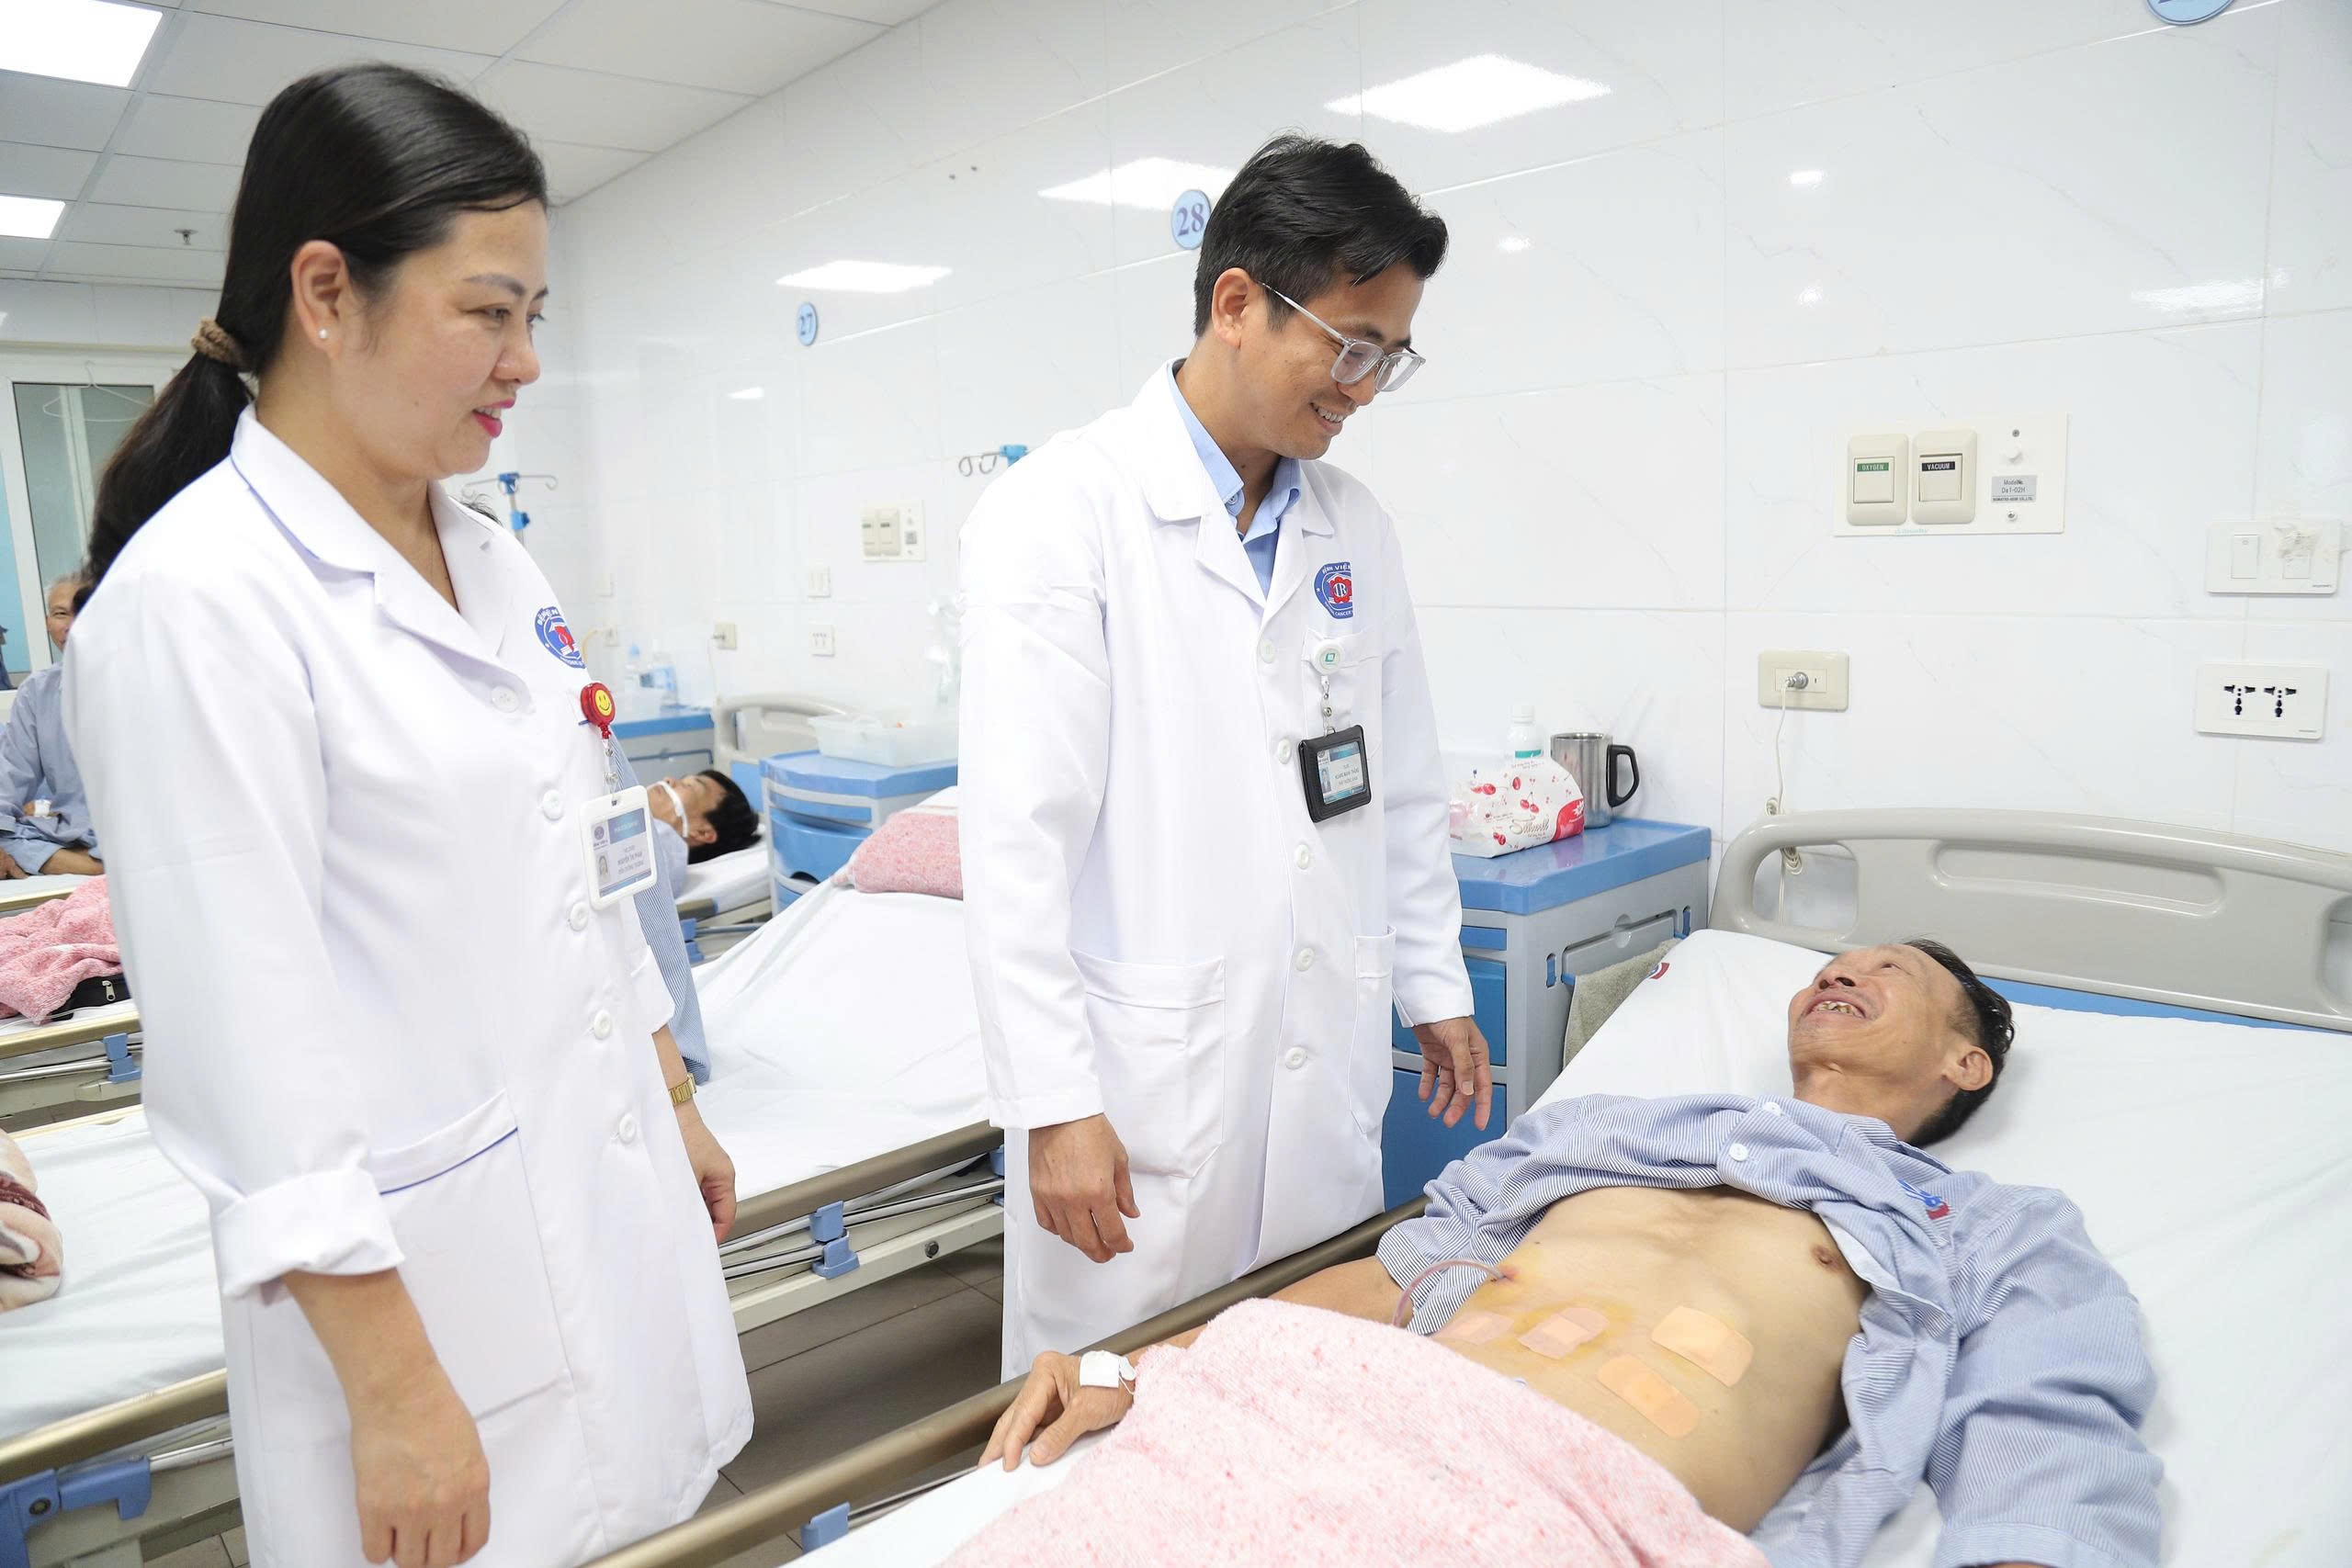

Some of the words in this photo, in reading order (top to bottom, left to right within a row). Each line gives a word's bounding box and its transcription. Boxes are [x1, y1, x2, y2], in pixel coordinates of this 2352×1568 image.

[1177, 203, 1204, 236] 28
[800, 312, 813, 336] 27
[1861, 463, 1884, 471] OXYGEN
[1927, 462, 1951, 470] VACUUM
